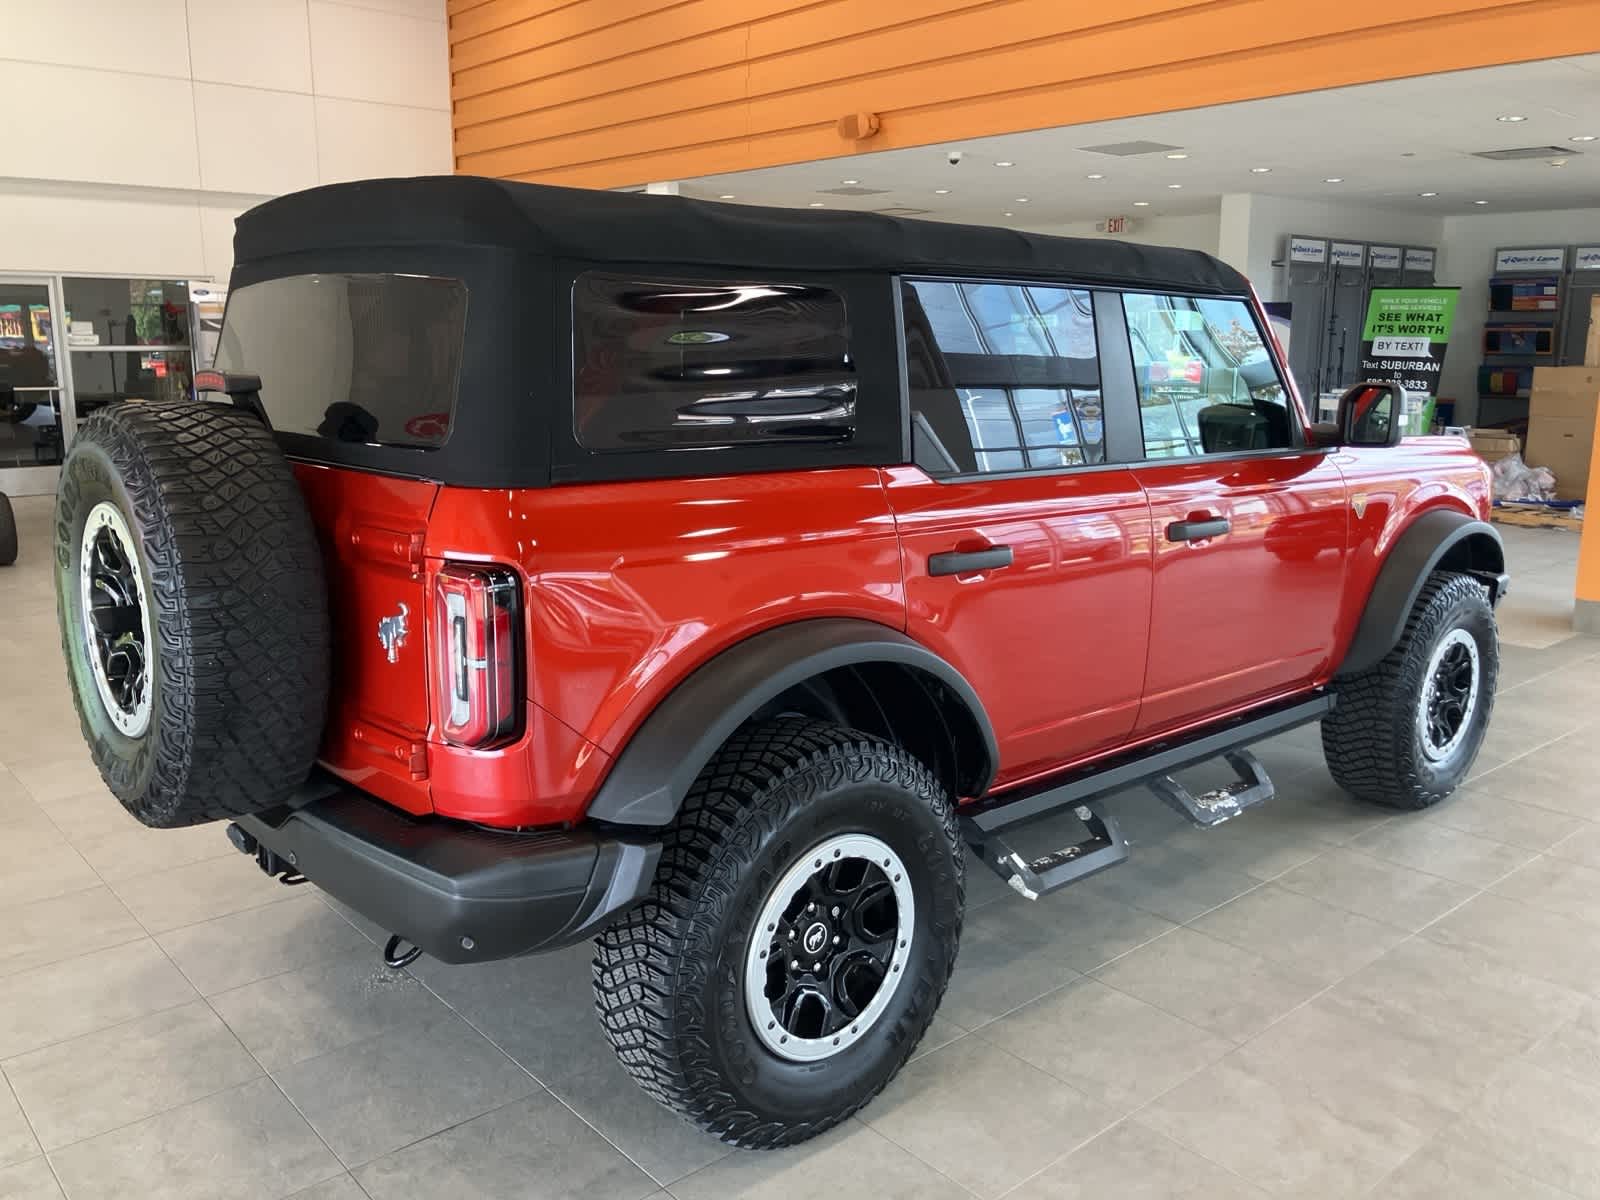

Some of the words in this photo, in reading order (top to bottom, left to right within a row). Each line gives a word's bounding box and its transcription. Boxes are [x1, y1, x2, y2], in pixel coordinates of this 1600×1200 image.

[1108, 217, 1125, 233] EXIT
[1378, 312, 1402, 322] SEE
[1405, 313, 1443, 322] WHAT
[1372, 324, 1394, 334] IT'S
[1398, 324, 1445, 335] WORTH
[1377, 341, 1392, 350] BY
[1395, 342, 1424, 351] TEXT!
[1362, 360, 1379, 369] Text
[1380, 360, 1440, 372] SUBURBAN
[1393, 371, 1402, 379] to
